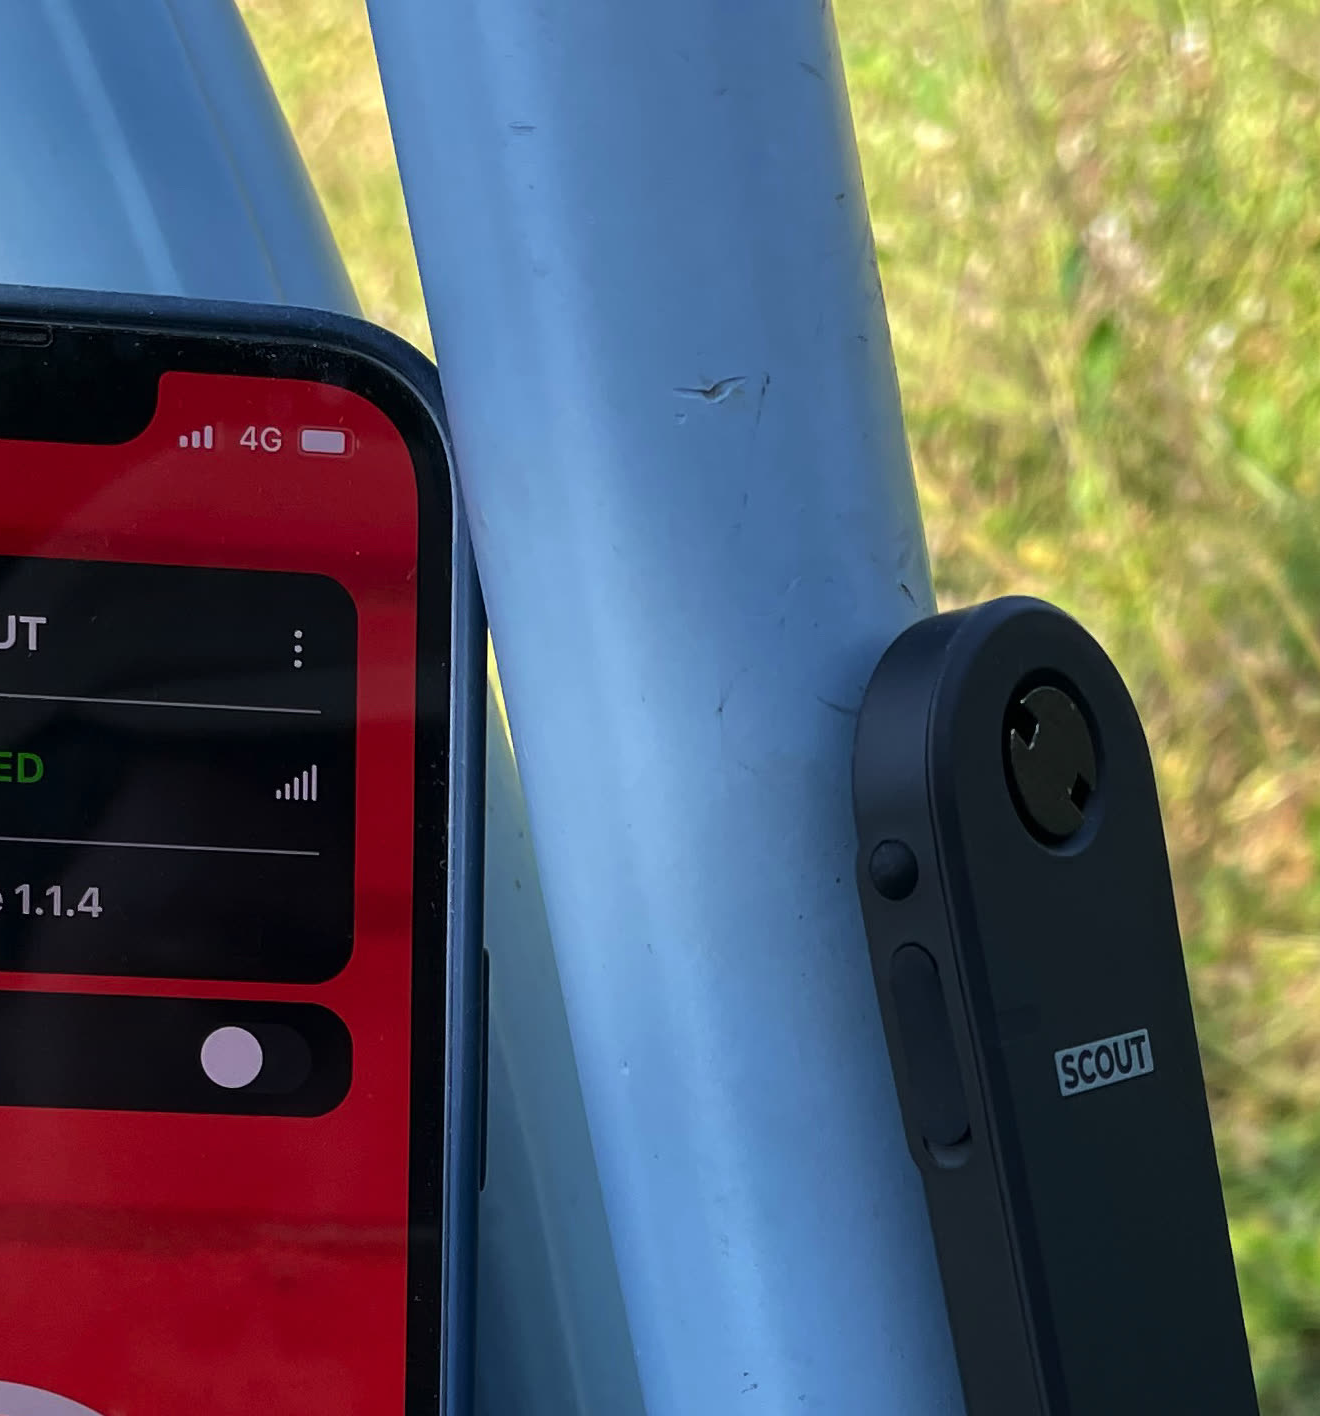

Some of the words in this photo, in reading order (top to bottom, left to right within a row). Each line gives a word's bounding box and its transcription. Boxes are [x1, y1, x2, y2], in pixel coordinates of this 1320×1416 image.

[238, 425, 283, 454] 4G
[13, 881, 103, 919] 1.1.4
[1060, 1034, 1147, 1090] SCOUT
